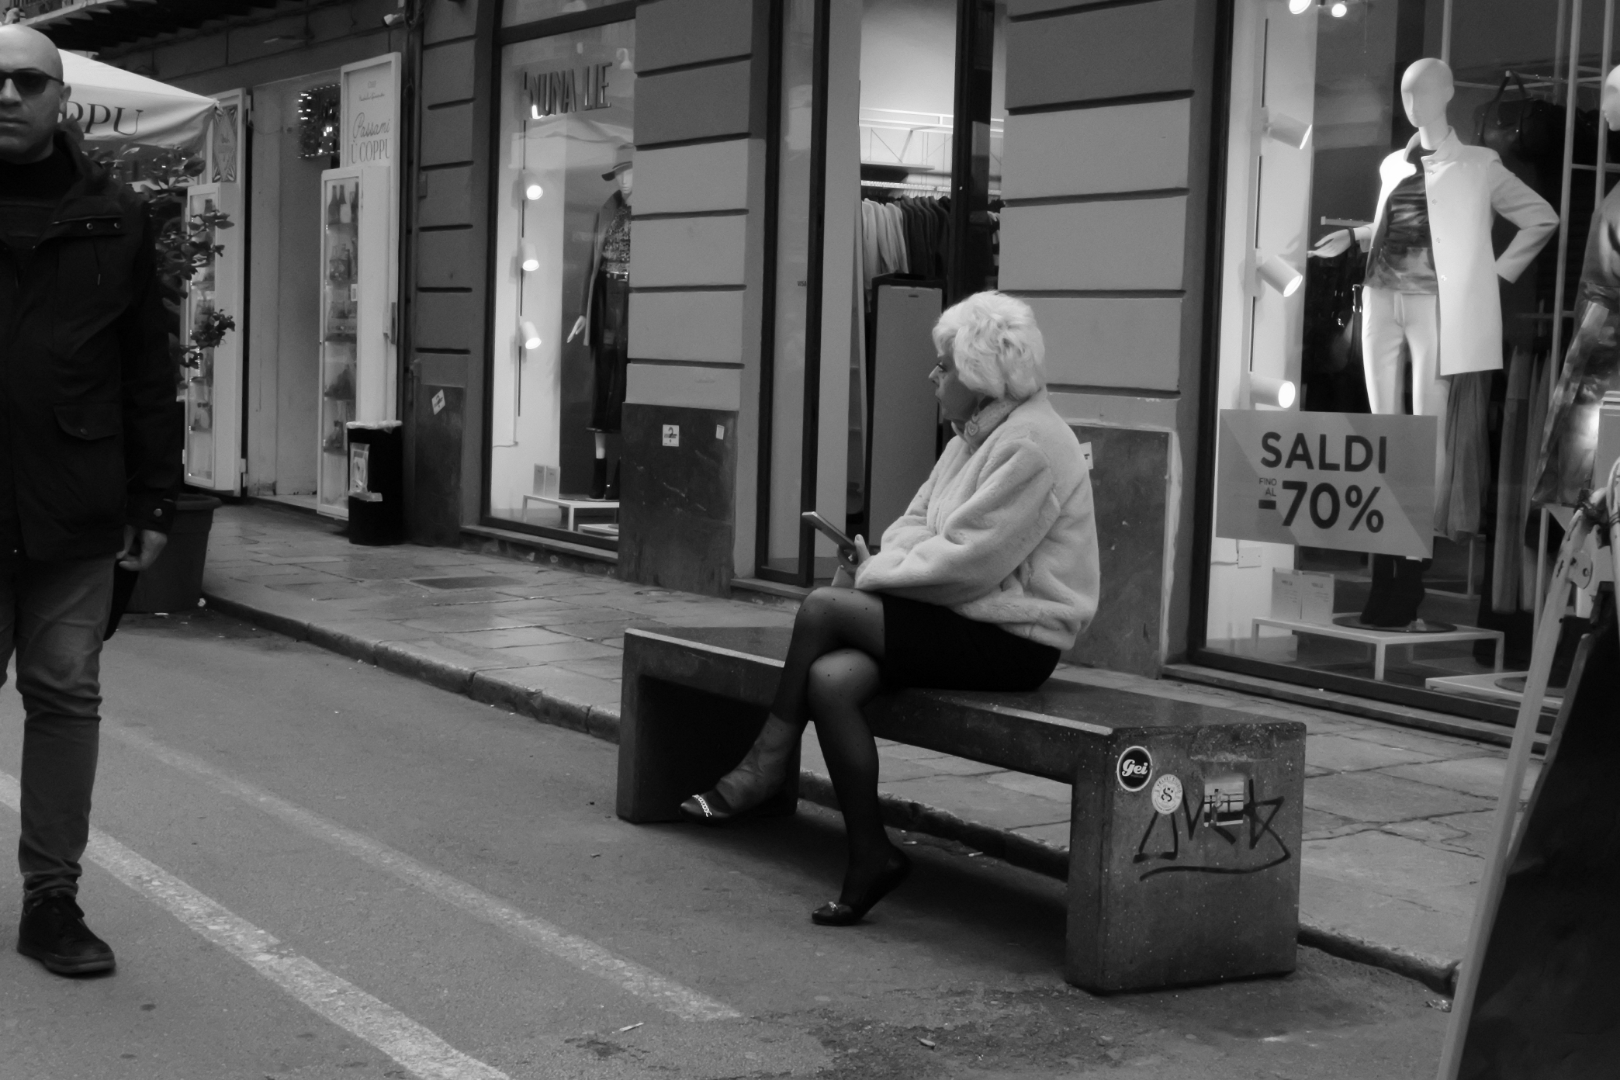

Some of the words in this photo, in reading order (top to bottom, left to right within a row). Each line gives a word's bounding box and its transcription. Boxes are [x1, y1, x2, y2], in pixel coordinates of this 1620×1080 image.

[1260, 431, 1387, 474] SALDI
[1258, 477, 1278, 486] FINO
[1265, 487, 1277, 497] AL
